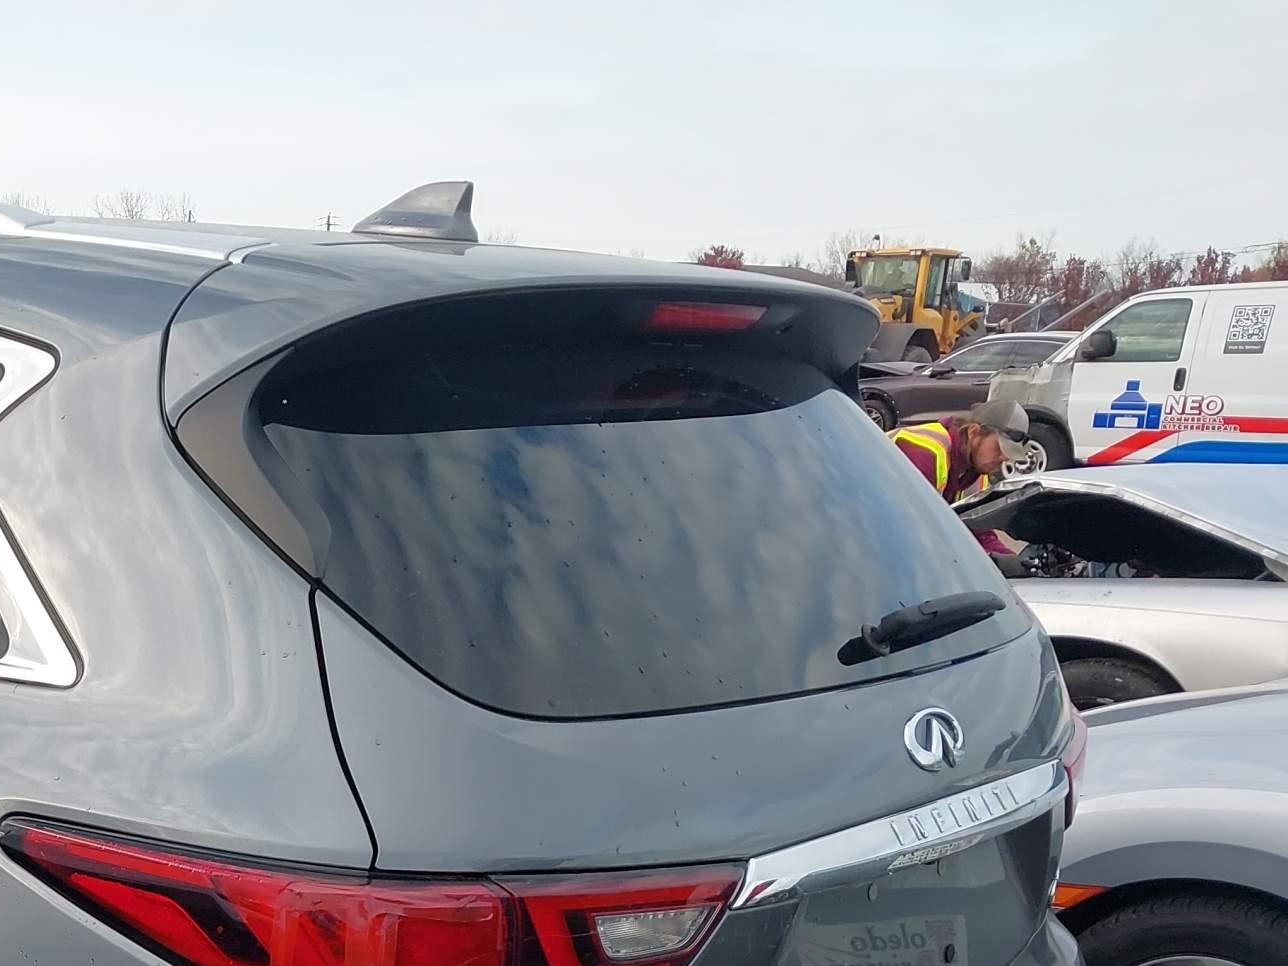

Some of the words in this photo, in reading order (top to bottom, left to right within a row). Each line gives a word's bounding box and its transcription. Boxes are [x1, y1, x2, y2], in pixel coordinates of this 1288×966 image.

[1164, 395, 1225, 417] NEO
[1163, 416, 1225, 424] COMMERCIAL
[1162, 424, 1202, 432] KITCHEN
[890, 782, 1020, 847] INFINITI
